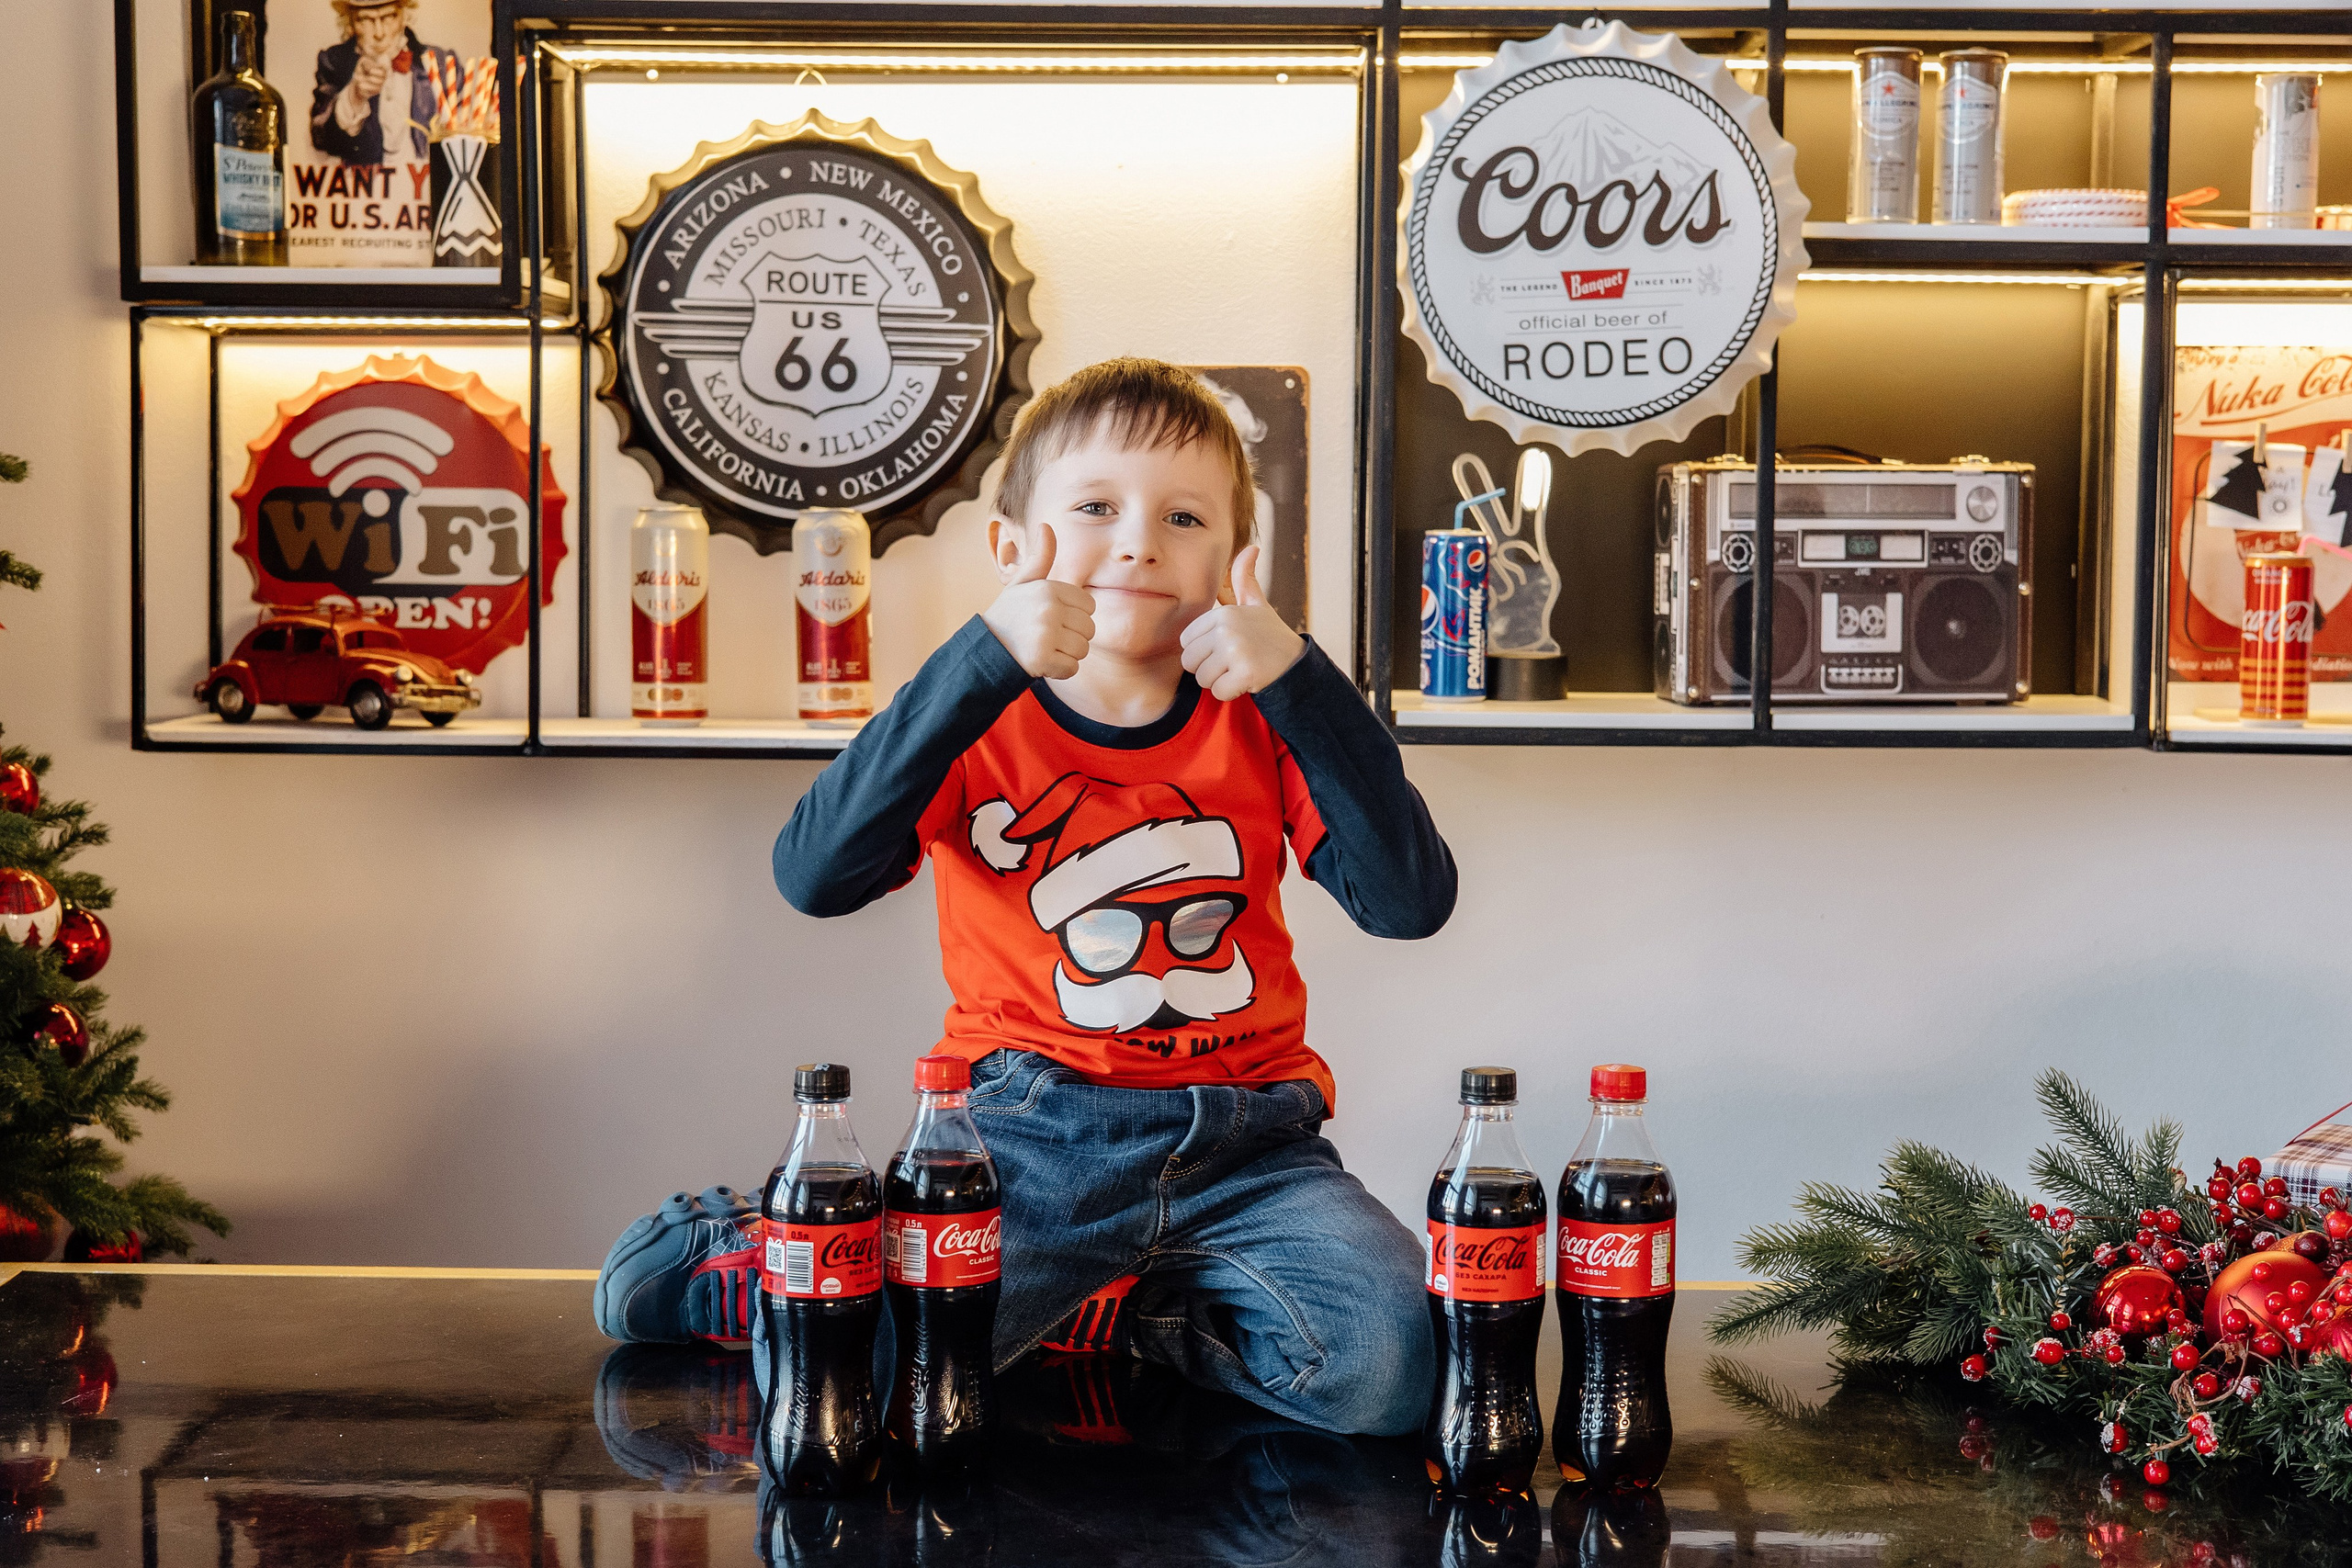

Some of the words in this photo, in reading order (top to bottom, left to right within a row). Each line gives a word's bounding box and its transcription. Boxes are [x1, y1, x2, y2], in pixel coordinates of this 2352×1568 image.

[294, 164, 396, 198] WANT
[1452, 146, 1731, 254] Coors
[662, 171, 768, 270] ARIZONA
[809, 160, 873, 190] NEW
[877, 182, 963, 276] MEXICO
[342, 238, 413, 248] RECRUITING
[703, 208, 827, 288] MISSOURI
[859, 220, 927, 297] TEXAS
[766, 271, 867, 297] ROUTE
[1570, 272, 1624, 299] Banquet
[792, 310, 842, 330] US
[1519, 315, 1587, 332] official
[1594, 313, 1640, 328] beer
[1648, 310, 1667, 324] of
[775, 336, 857, 392] 66
[1503, 336, 1693, 381] RODEO
[2191, 375, 2285, 417] Nuka
[2298, 355, 2352, 399] Col
[705, 370, 791, 453] KANSAS
[819, 377, 925, 457] ILLINOIS
[662, 387, 805, 502] CALIFORNIA
[839, 392, 967, 500] OKLAHOMA
[635, 570, 700, 587] Aldaris
[798, 570, 865, 587] Aldaris
[813, 597, 853, 612] 1865
[969, 1255, 994, 1265] CLASSIC
[1435, 1234, 1531, 1270] Coca-Cola
[1558, 1226, 1646, 1268] Coca-Cola
[1575, 1267, 1608, 1276] CLASSIC
